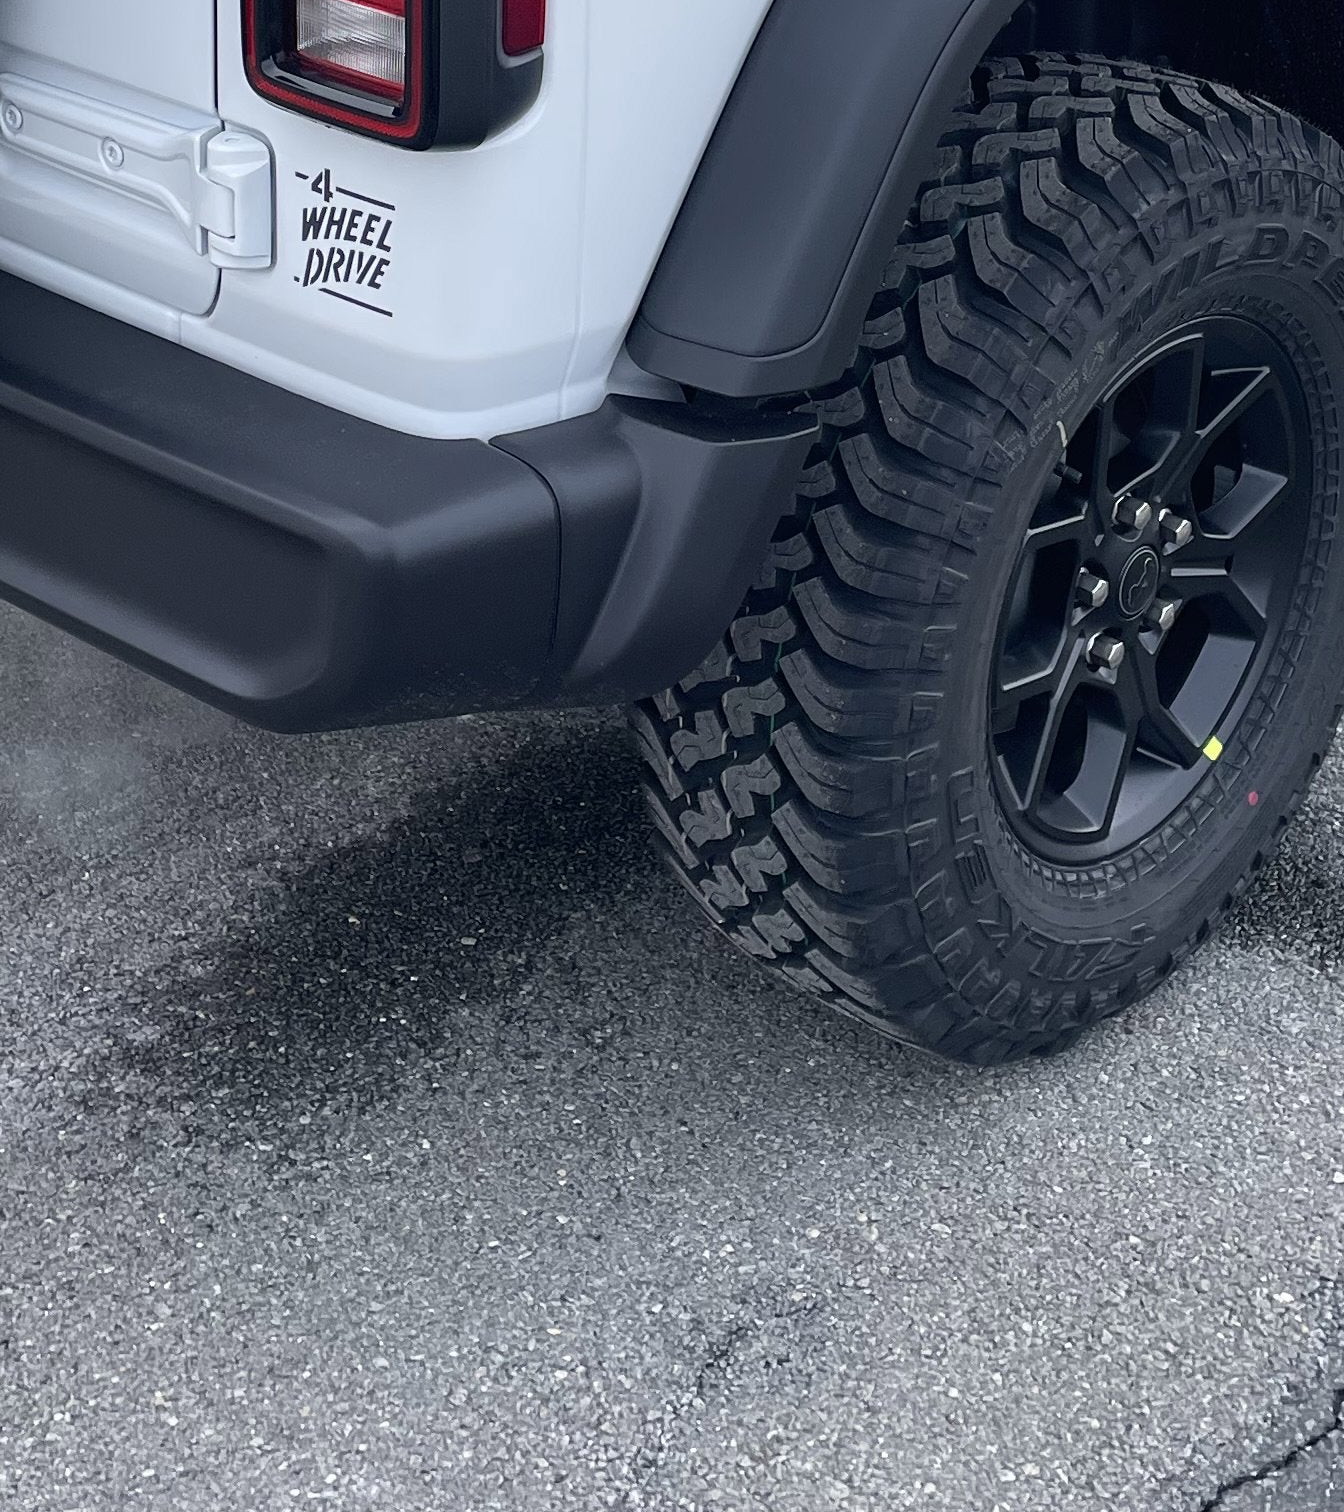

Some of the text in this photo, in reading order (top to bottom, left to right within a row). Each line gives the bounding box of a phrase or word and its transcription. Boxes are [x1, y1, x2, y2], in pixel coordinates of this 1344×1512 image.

[310, 168, 334, 203] 4
[301, 206, 394, 253] WHEEL
[302, 246, 391, 290] DRIVE
